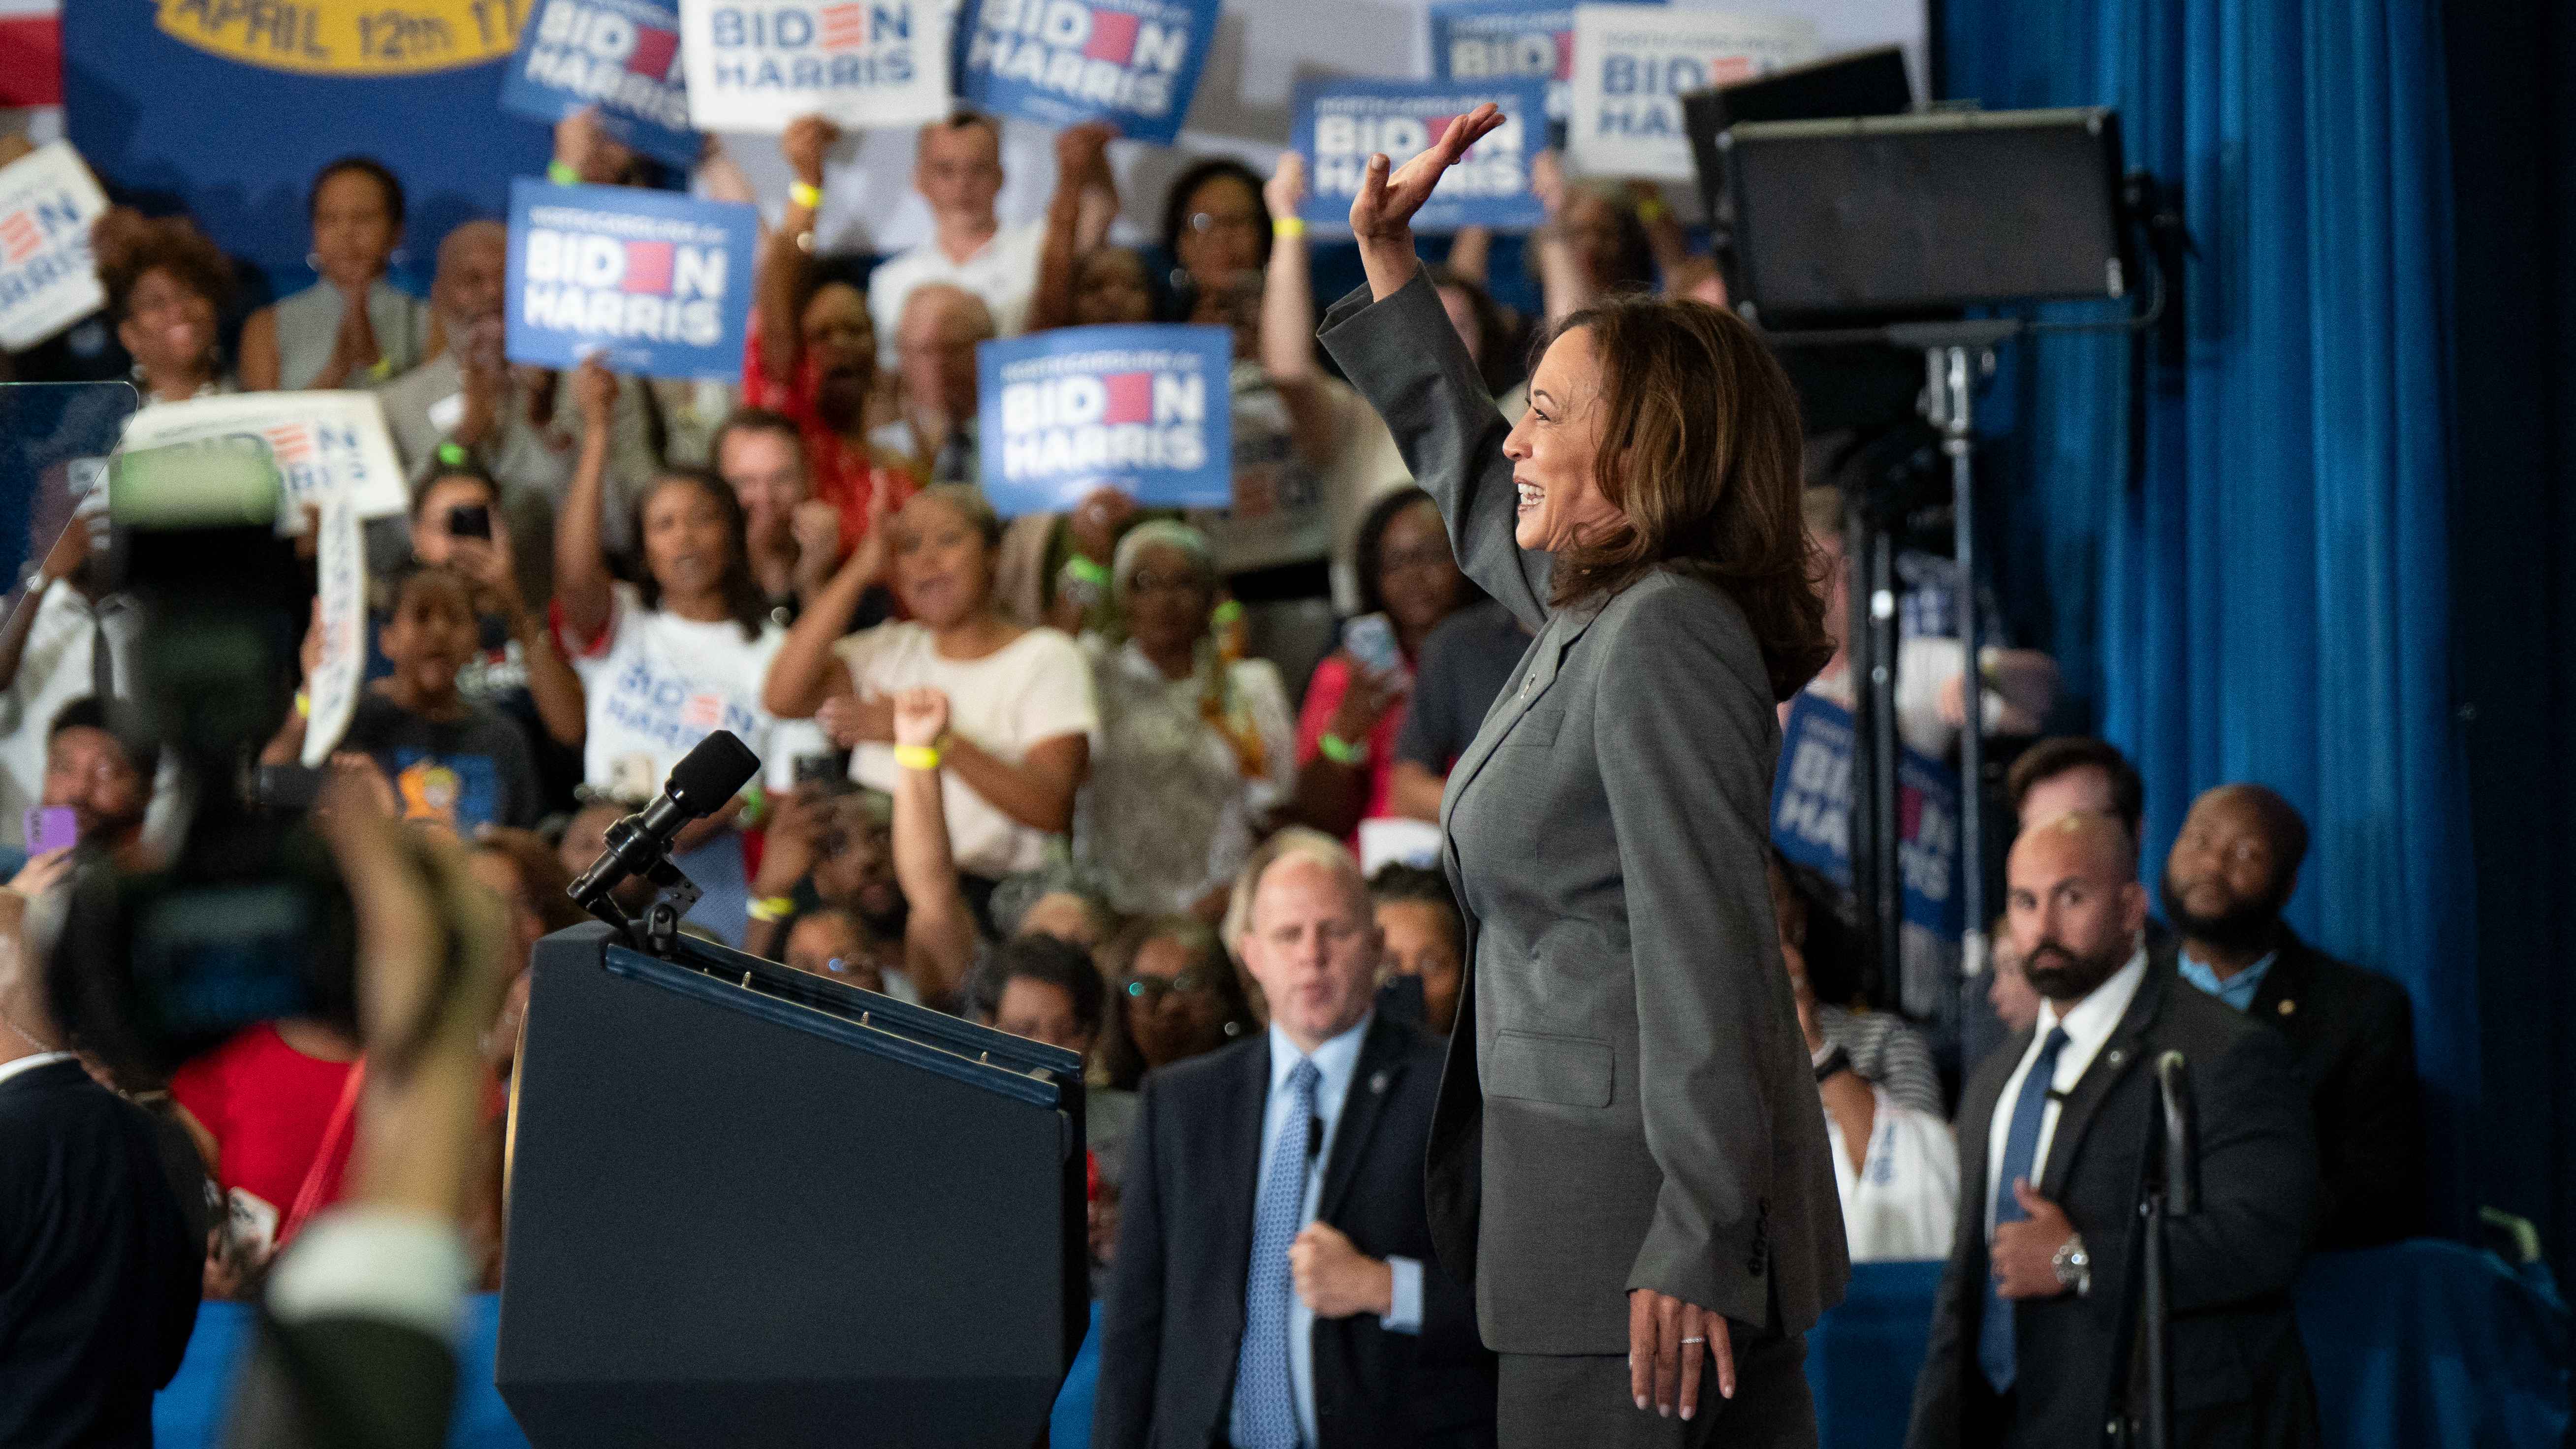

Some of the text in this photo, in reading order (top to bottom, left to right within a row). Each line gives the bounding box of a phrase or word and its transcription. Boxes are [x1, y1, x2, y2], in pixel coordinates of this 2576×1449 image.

[536, 0, 685, 82] BIDE
[711, 2, 911, 52] BIDEN
[979, 0, 1187, 70] BIDEN
[713, 50, 914, 90] HARRIS
[966, 30, 1174, 116] HARRIS
[527, 228, 728, 296] BIDEN
[523, 283, 723, 346] HARRIS
[1000, 371, 1205, 433] BIDEN
[1003, 423, 1208, 481] HARRIS
